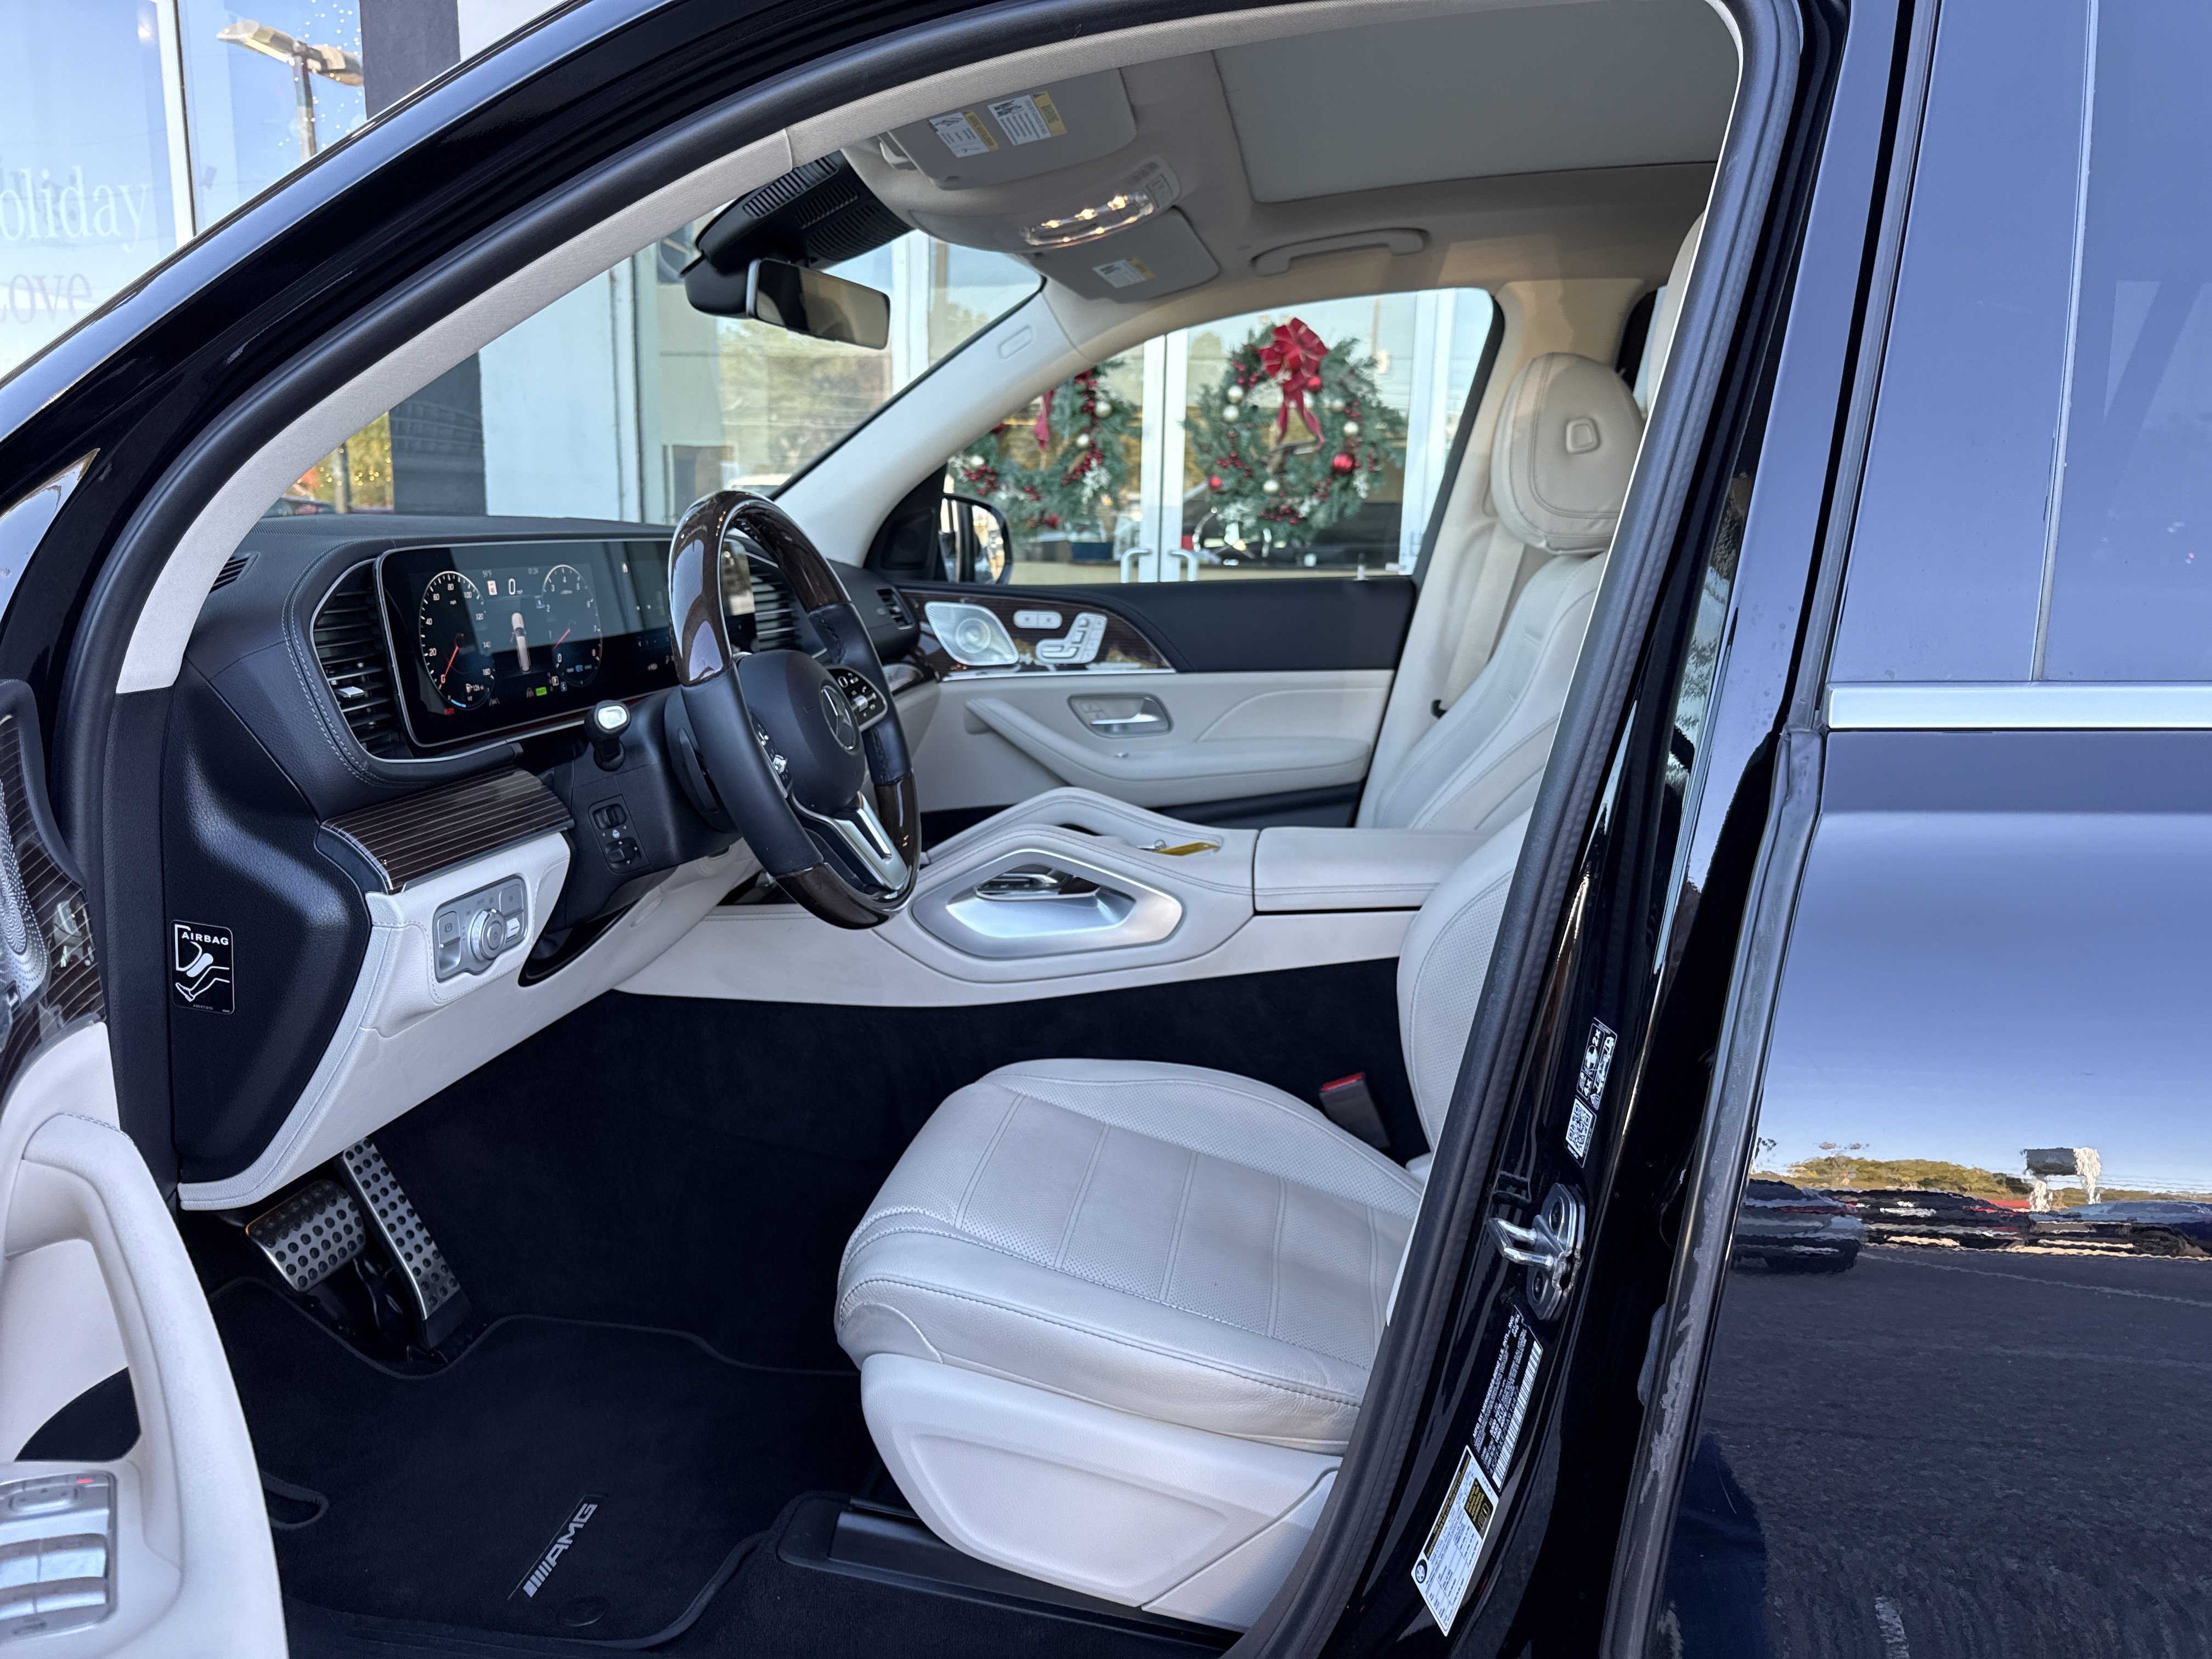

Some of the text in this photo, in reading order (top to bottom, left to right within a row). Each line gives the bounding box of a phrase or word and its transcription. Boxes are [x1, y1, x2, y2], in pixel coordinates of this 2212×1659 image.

[0, 273, 92, 325] ove
[509, 578, 516, 595] 0
[429, 648, 437, 657] 20
[557, 653, 562, 663] 0
[441, 674, 446, 684] 0
[182, 932, 229, 945] AIRBAG
[1592, 1029, 1601, 1047] 2x
[1584, 1079, 1592, 1097] 4x
[1481, 1359, 1500, 1414] MERCEDES-BENZ
[545, 1503, 598, 1568] AMG
